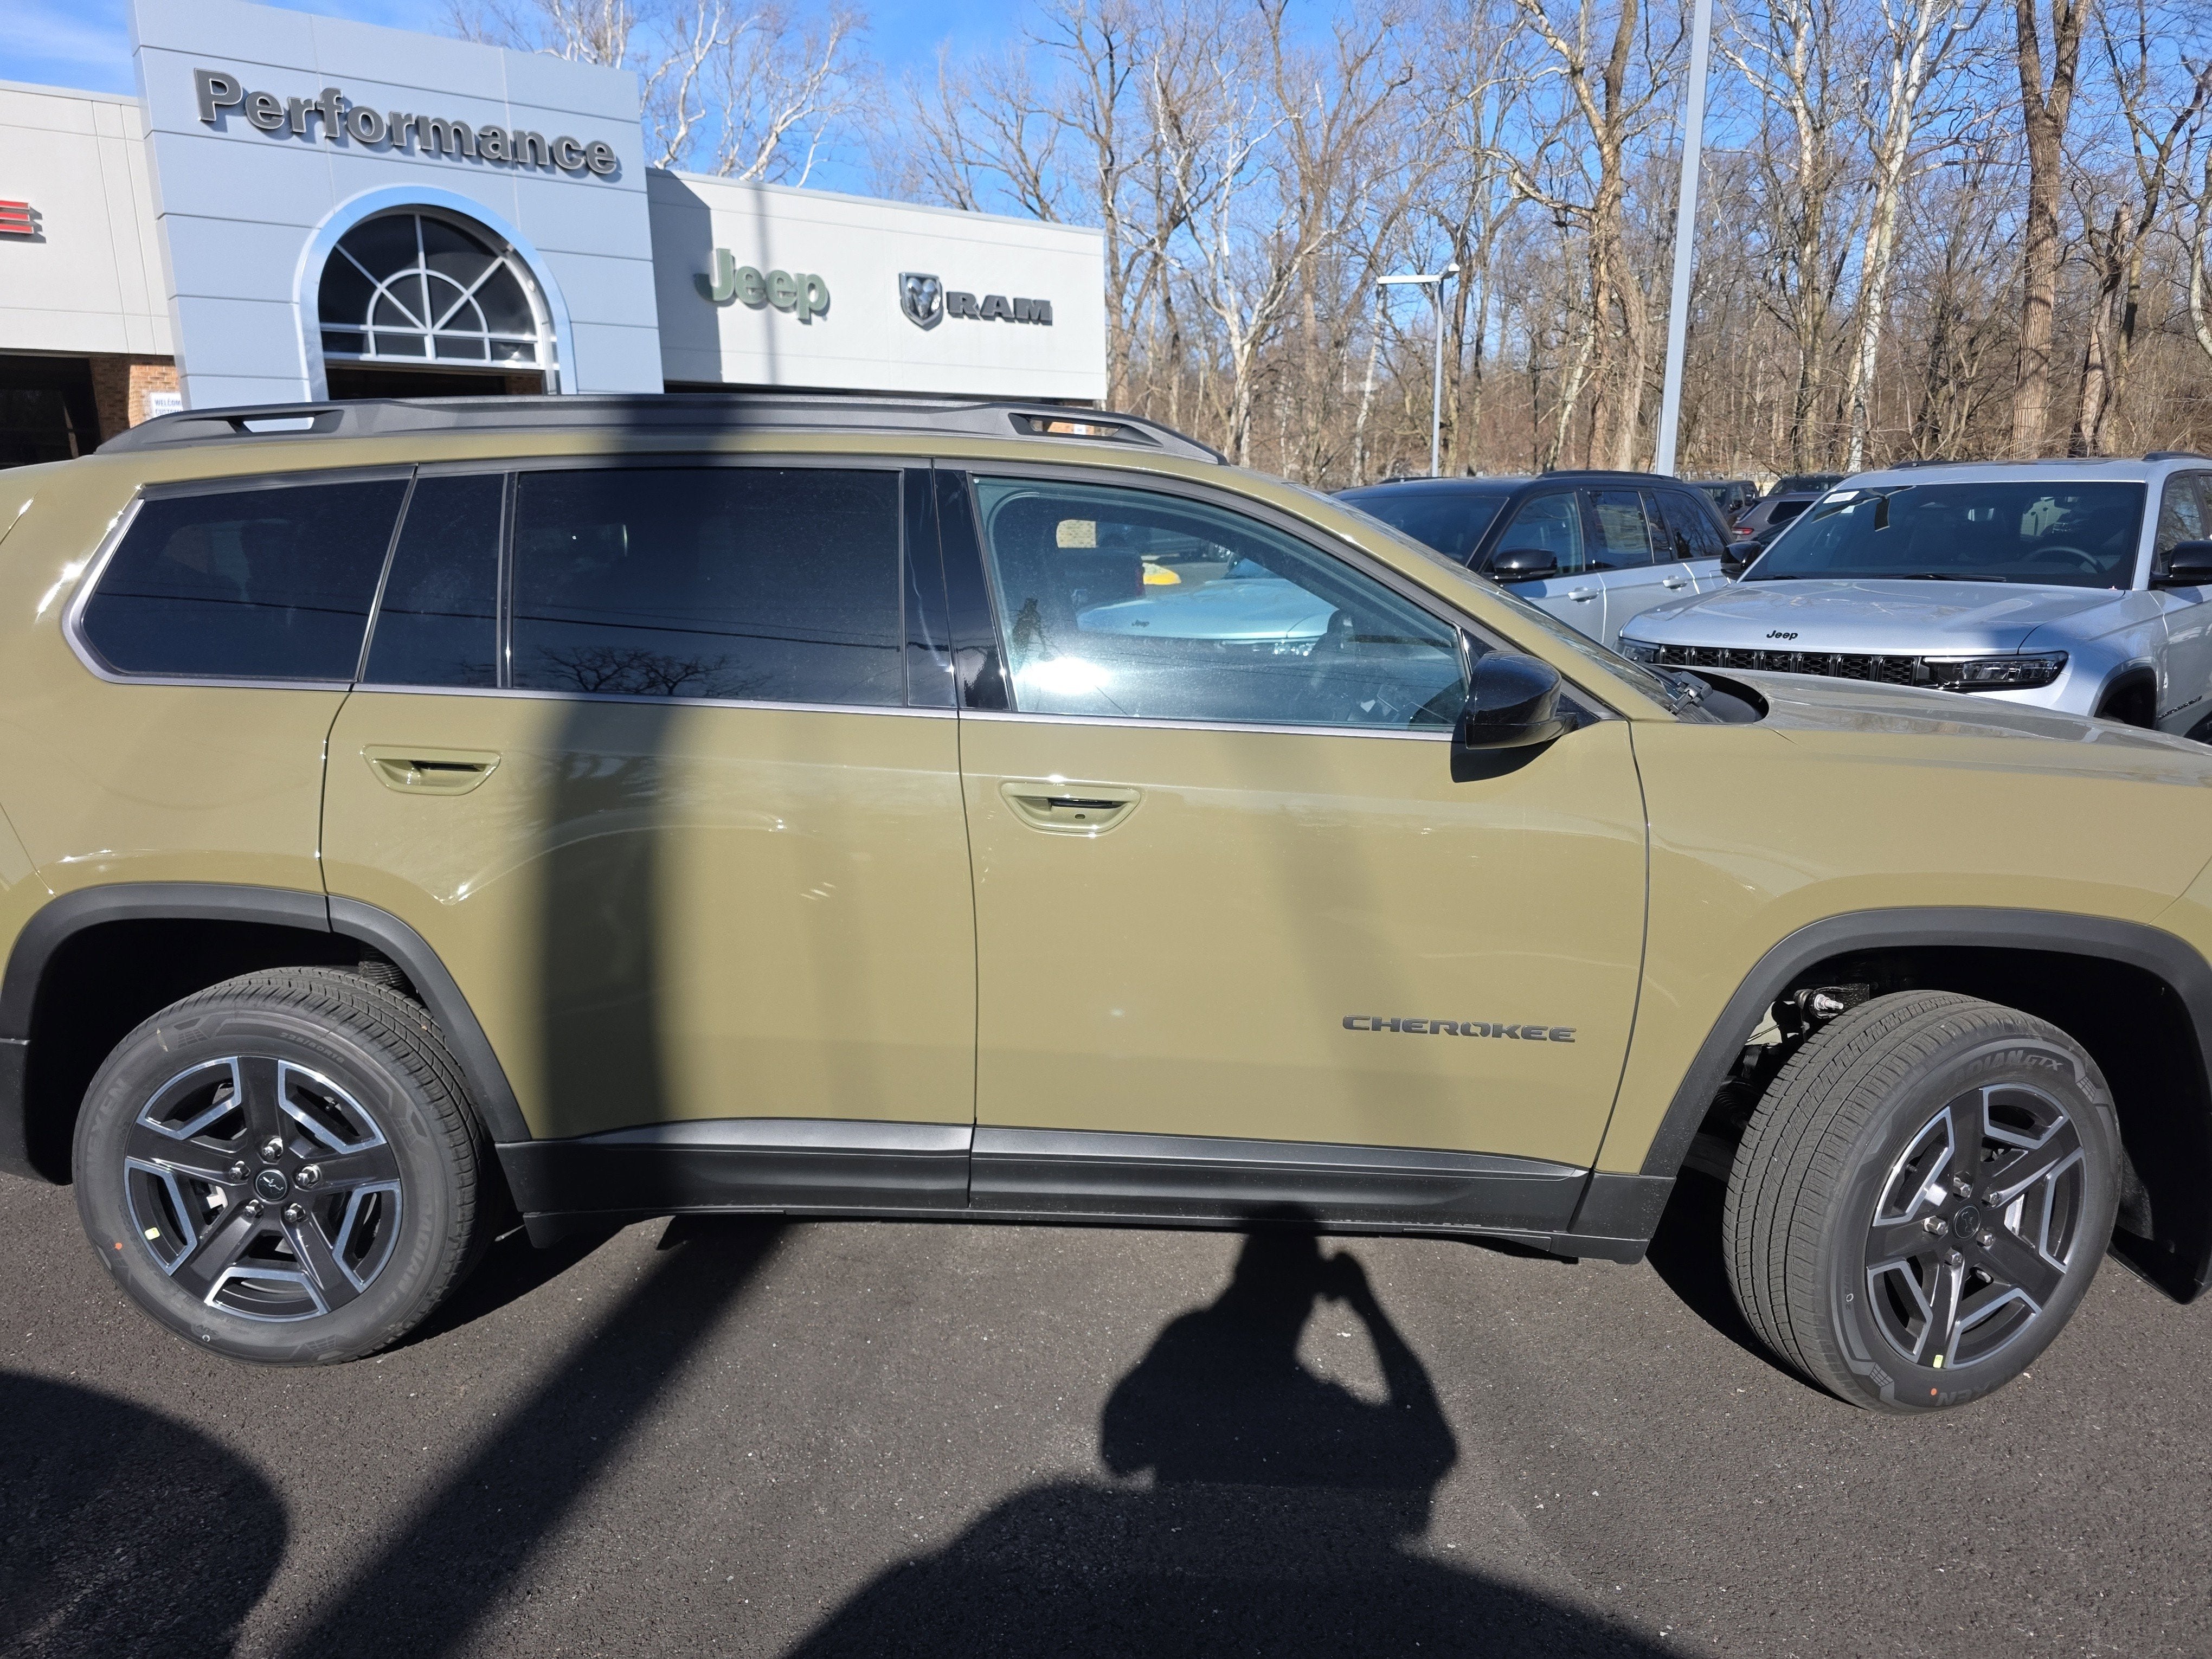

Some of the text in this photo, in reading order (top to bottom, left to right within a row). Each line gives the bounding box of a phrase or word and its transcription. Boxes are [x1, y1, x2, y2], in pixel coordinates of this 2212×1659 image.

[194, 67, 618, 175] Performance
[693, 248, 828, 320] Jeep
[946, 291, 1052, 324] RAM
[155, 398, 182, 406] WELCOM
[1766, 630, 1798, 640] Jeep
[1342, 1015, 1577, 1043] CHEROKEE
[2024, 1054, 2064, 1071] GTX
